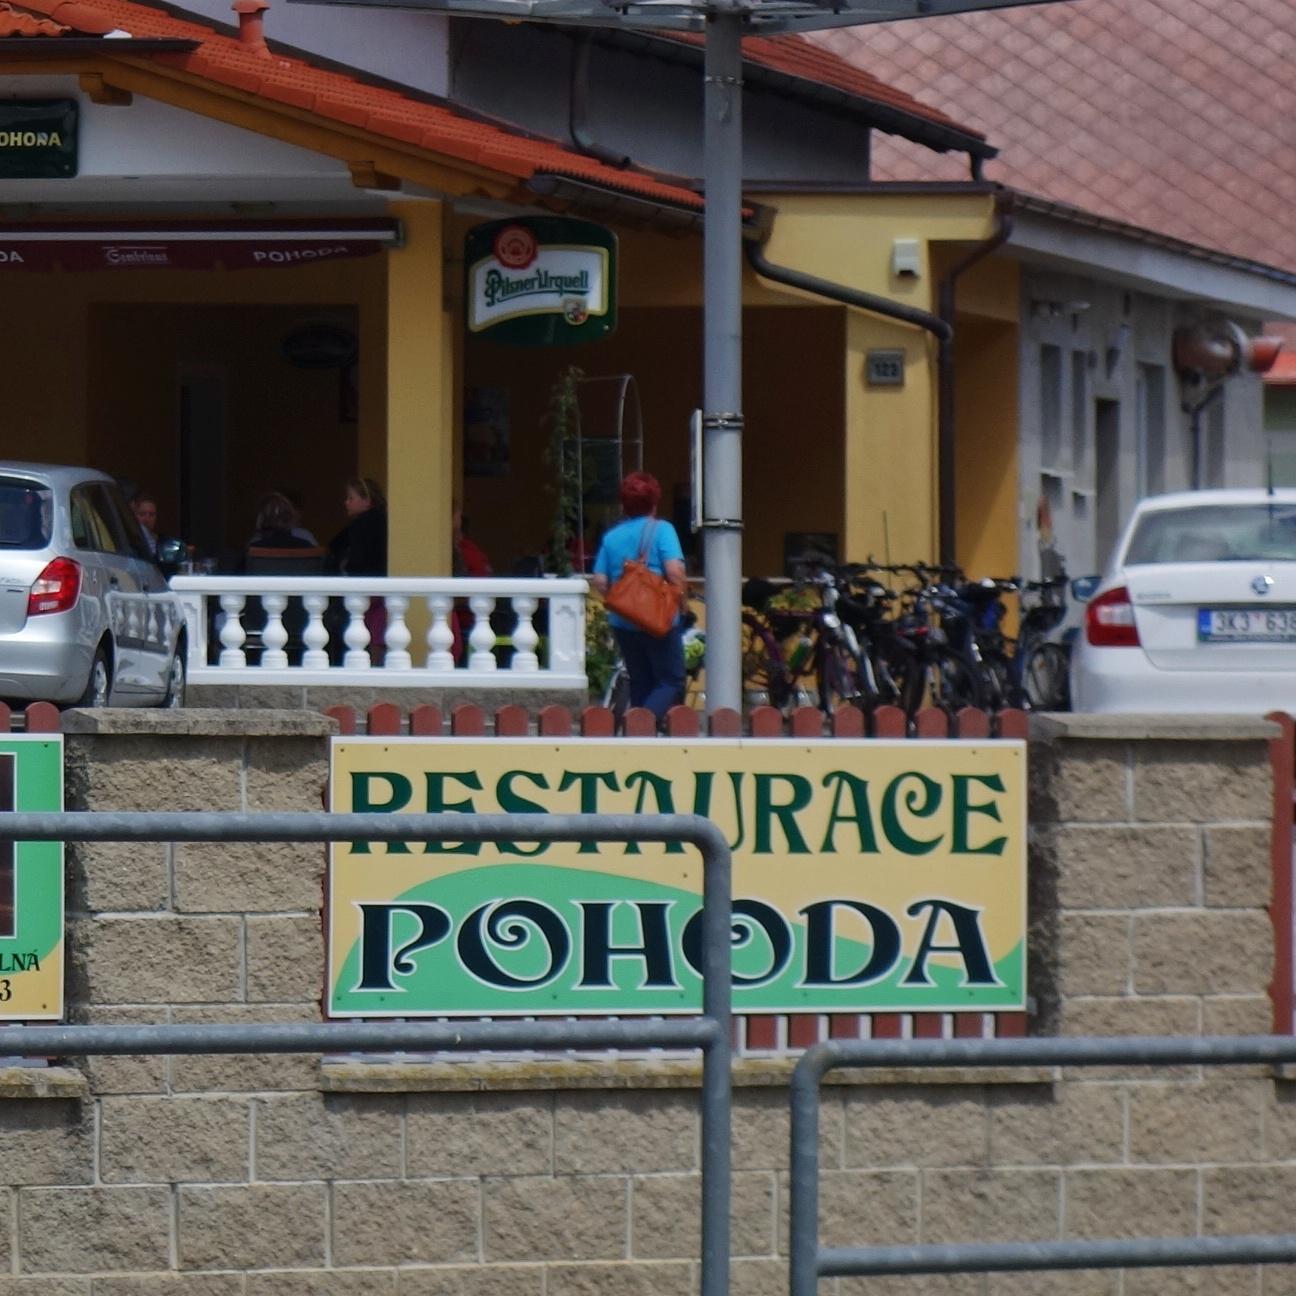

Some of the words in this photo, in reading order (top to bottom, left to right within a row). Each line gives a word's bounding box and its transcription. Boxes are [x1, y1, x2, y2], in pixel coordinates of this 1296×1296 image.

[253, 245, 349, 263] POHODA
[485, 269, 538, 307] Pilsner
[537, 268, 590, 296] Urquell
[349, 770, 1009, 856] RESTAURACE
[354, 899, 1003, 990] POHODA
